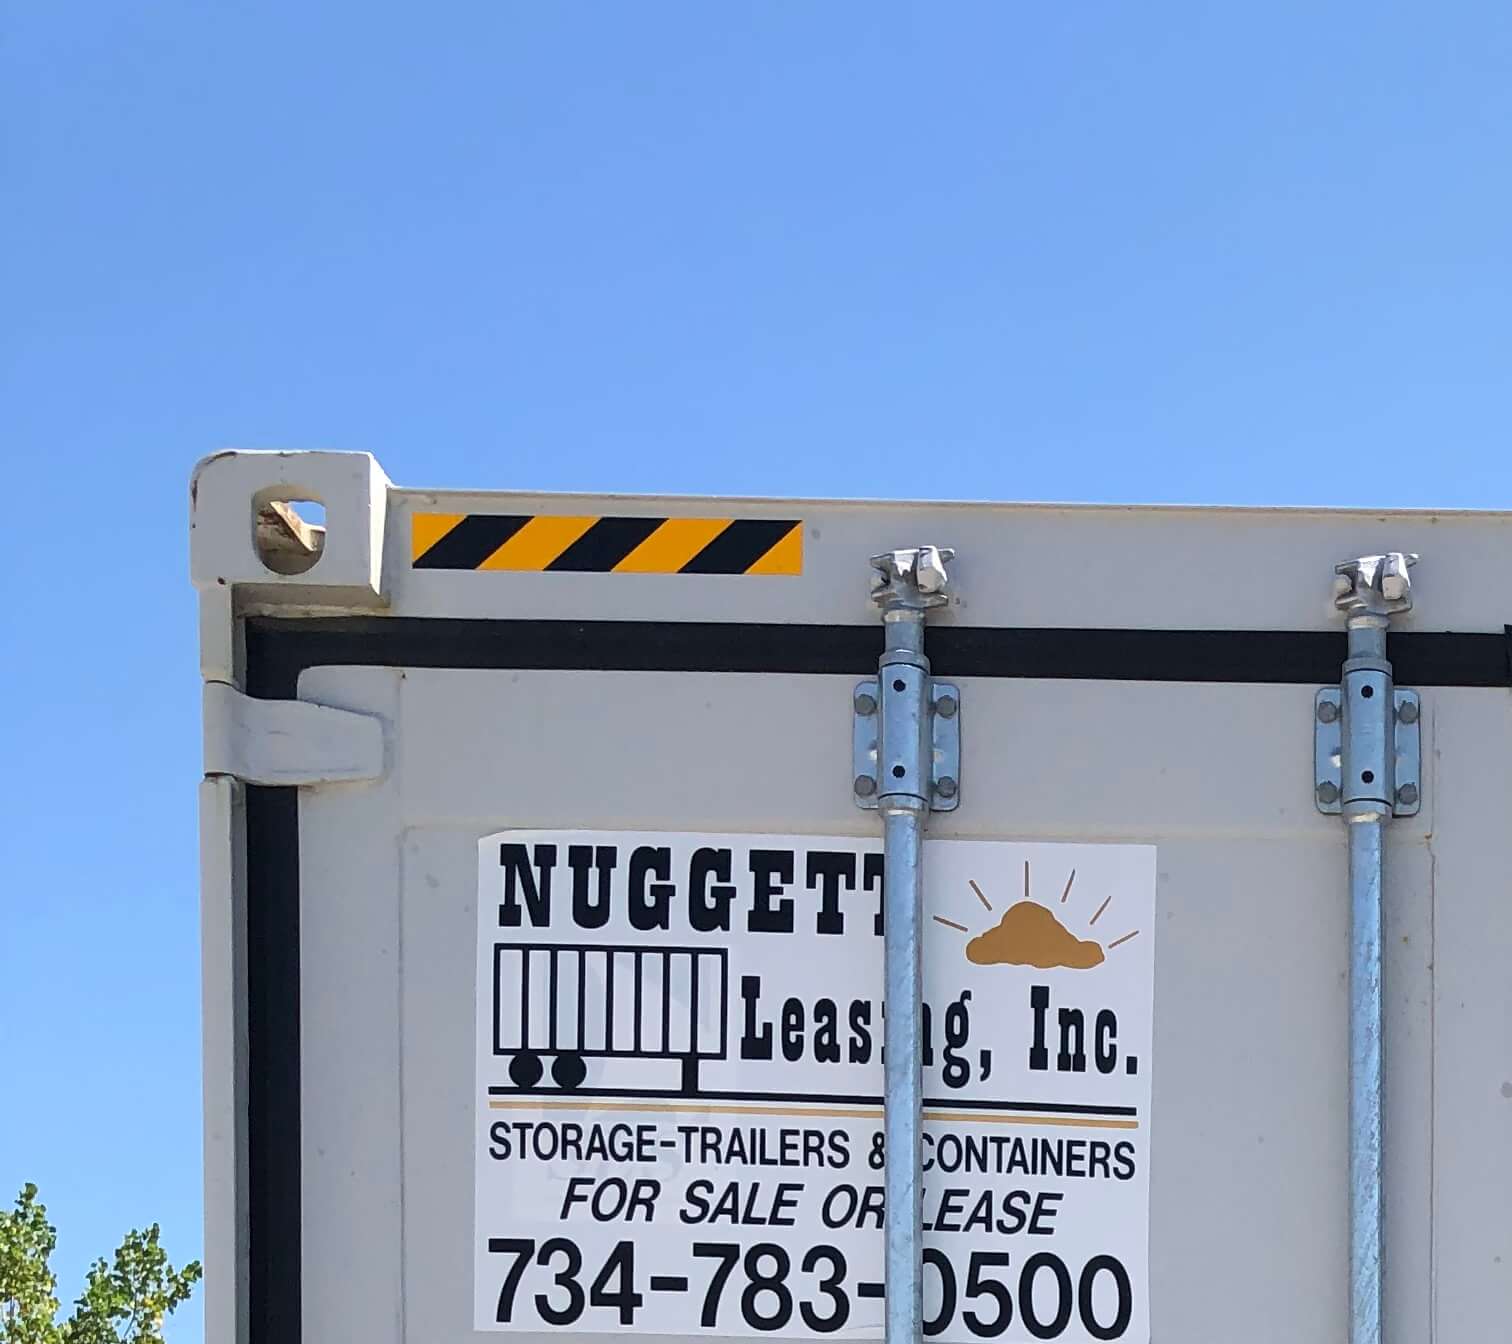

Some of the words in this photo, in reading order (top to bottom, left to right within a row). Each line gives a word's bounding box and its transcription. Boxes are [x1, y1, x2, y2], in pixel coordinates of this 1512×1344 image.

[1029, 984, 1138, 1075] Inc.
[489, 1121, 850, 1169] STORAGE-TRAILERS
[560, 1177, 661, 1222] FOR
[679, 1179, 804, 1228] SALE
[821, 1184, 885, 1229] OR
[488, 1238, 1134, 1342] 734-783-0500
